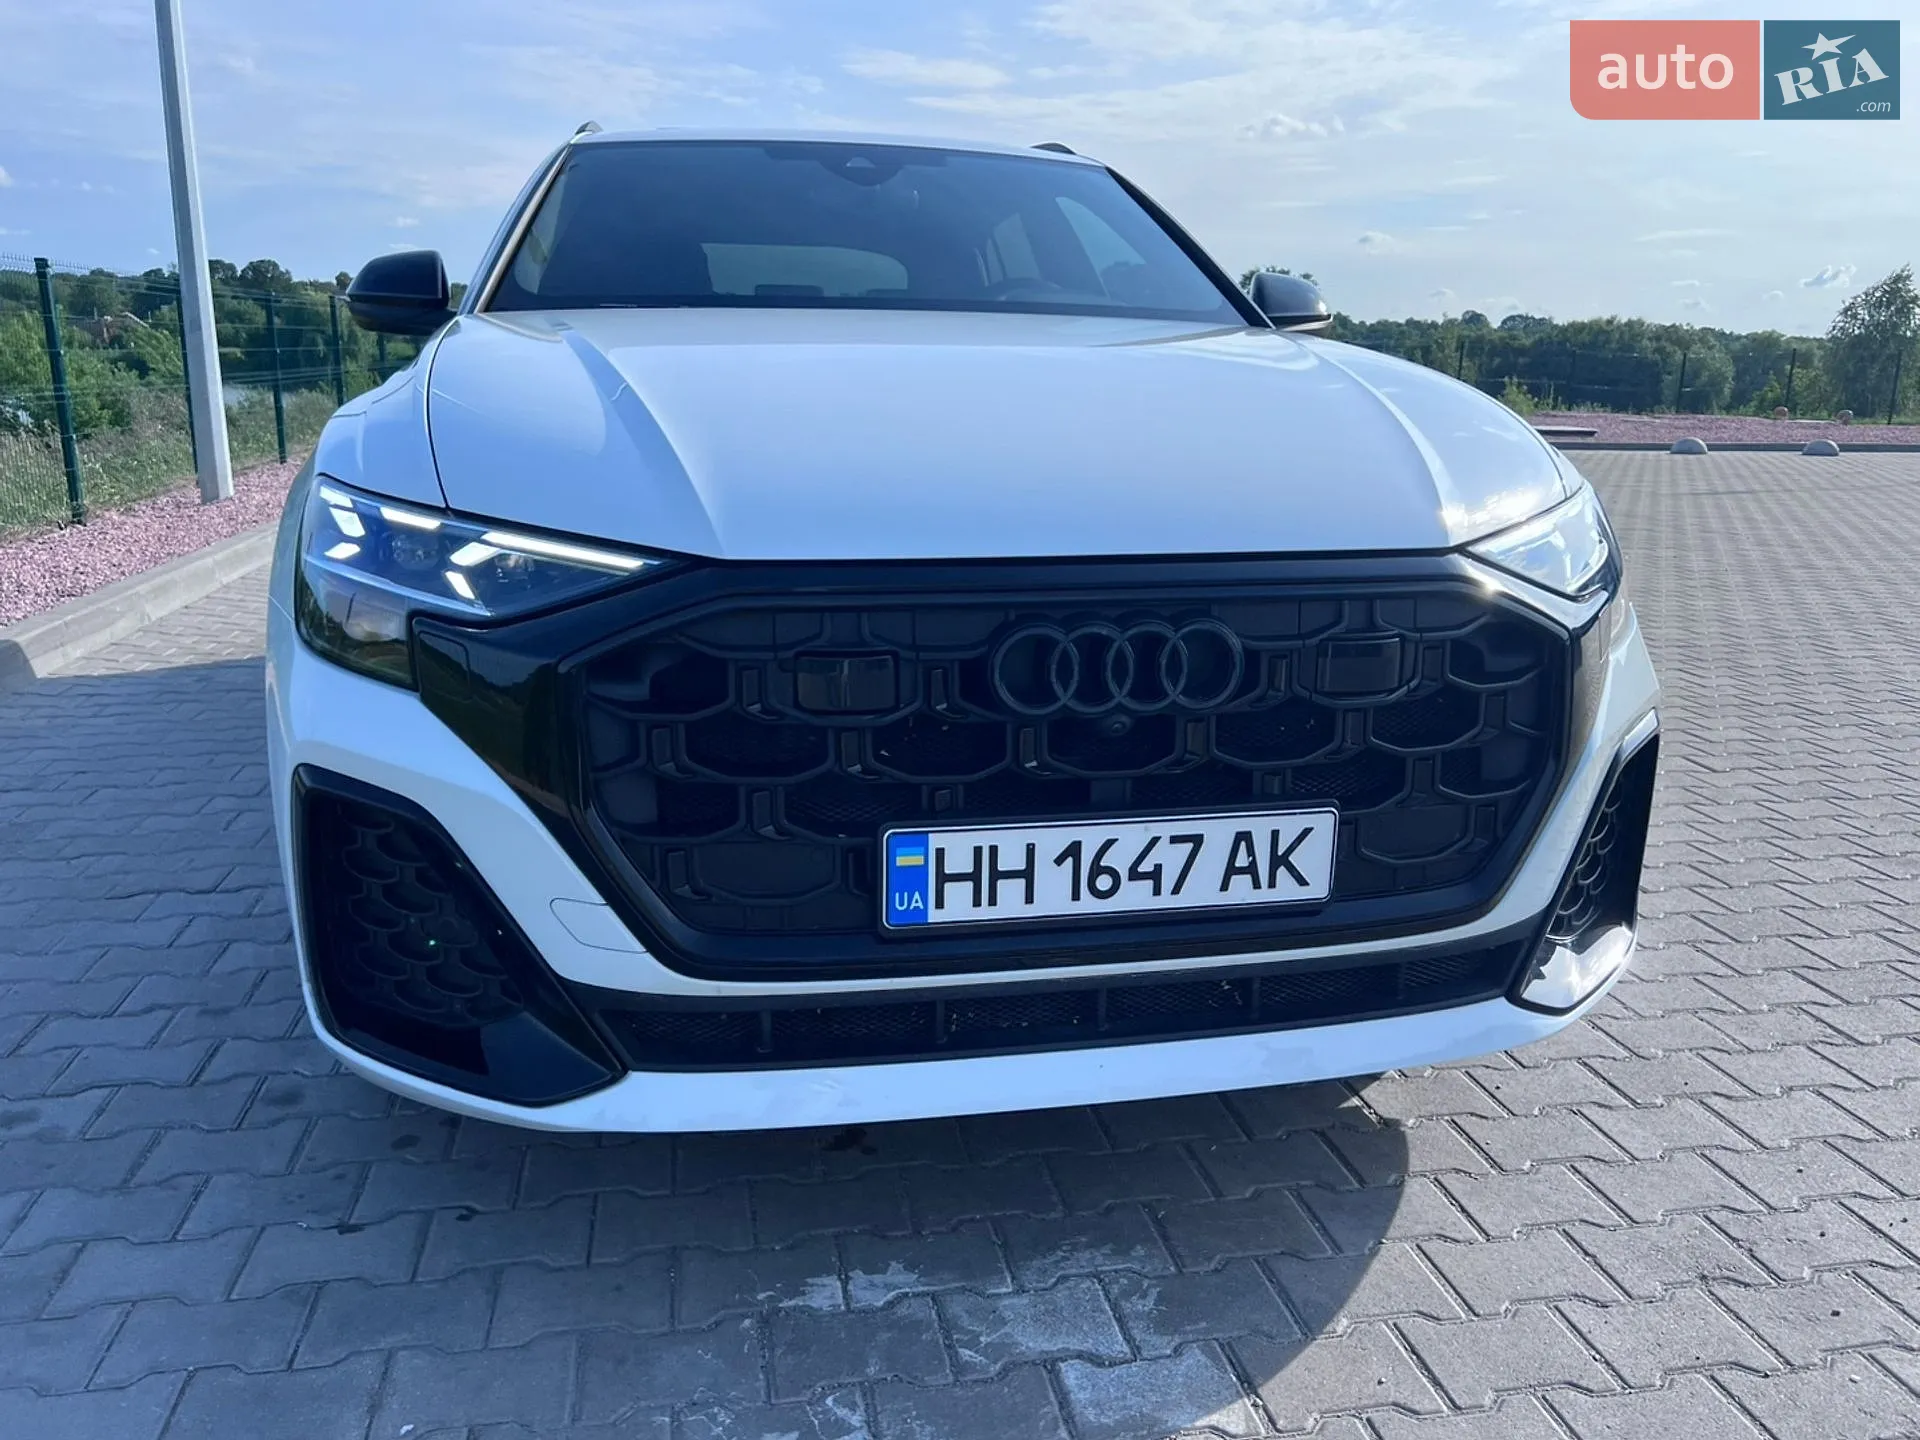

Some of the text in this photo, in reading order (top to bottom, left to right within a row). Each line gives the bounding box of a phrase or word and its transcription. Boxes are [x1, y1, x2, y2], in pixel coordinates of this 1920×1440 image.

[934, 827, 1315, 909] HH 1647 AK
[895, 891, 924, 911] UA
